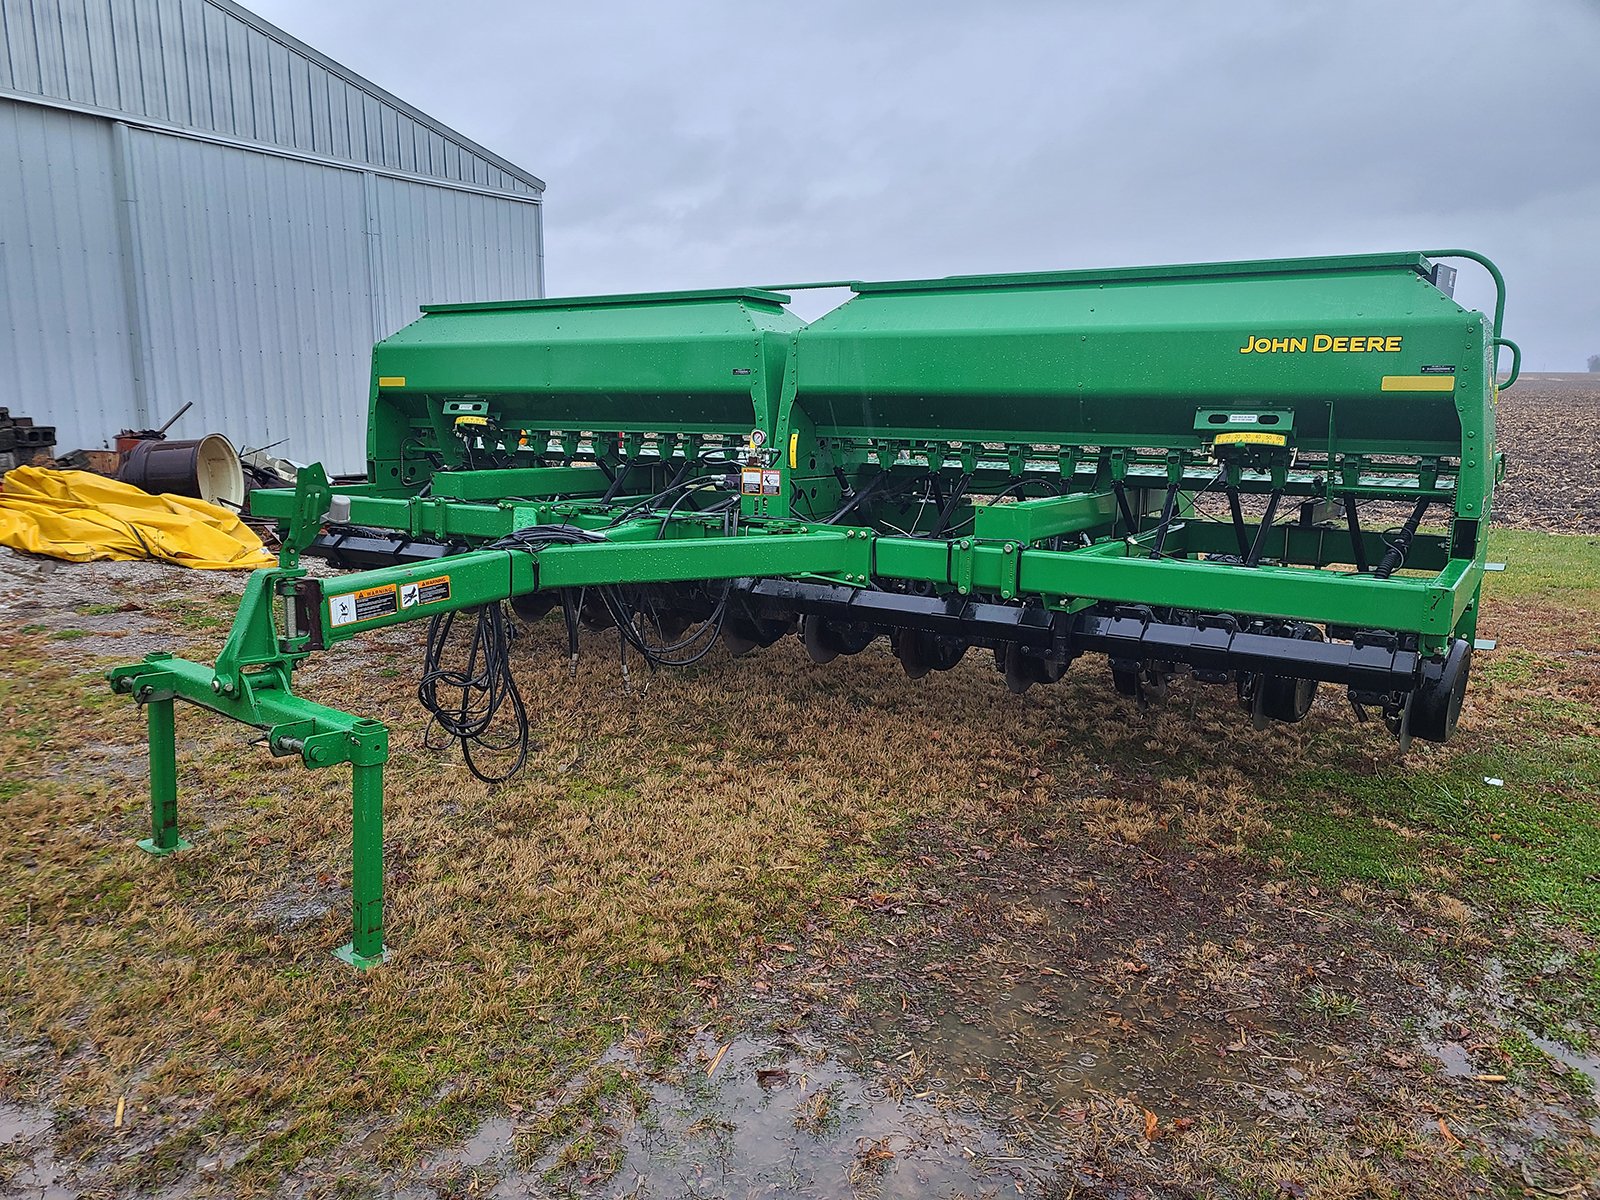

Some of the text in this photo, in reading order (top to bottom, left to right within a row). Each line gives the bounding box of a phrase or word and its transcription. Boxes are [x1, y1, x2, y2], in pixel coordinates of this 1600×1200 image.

[1240, 334, 1403, 354] JOHN DEERE
[425, 577, 446, 585] WARNING
[366, 587, 393, 597] WARNING
